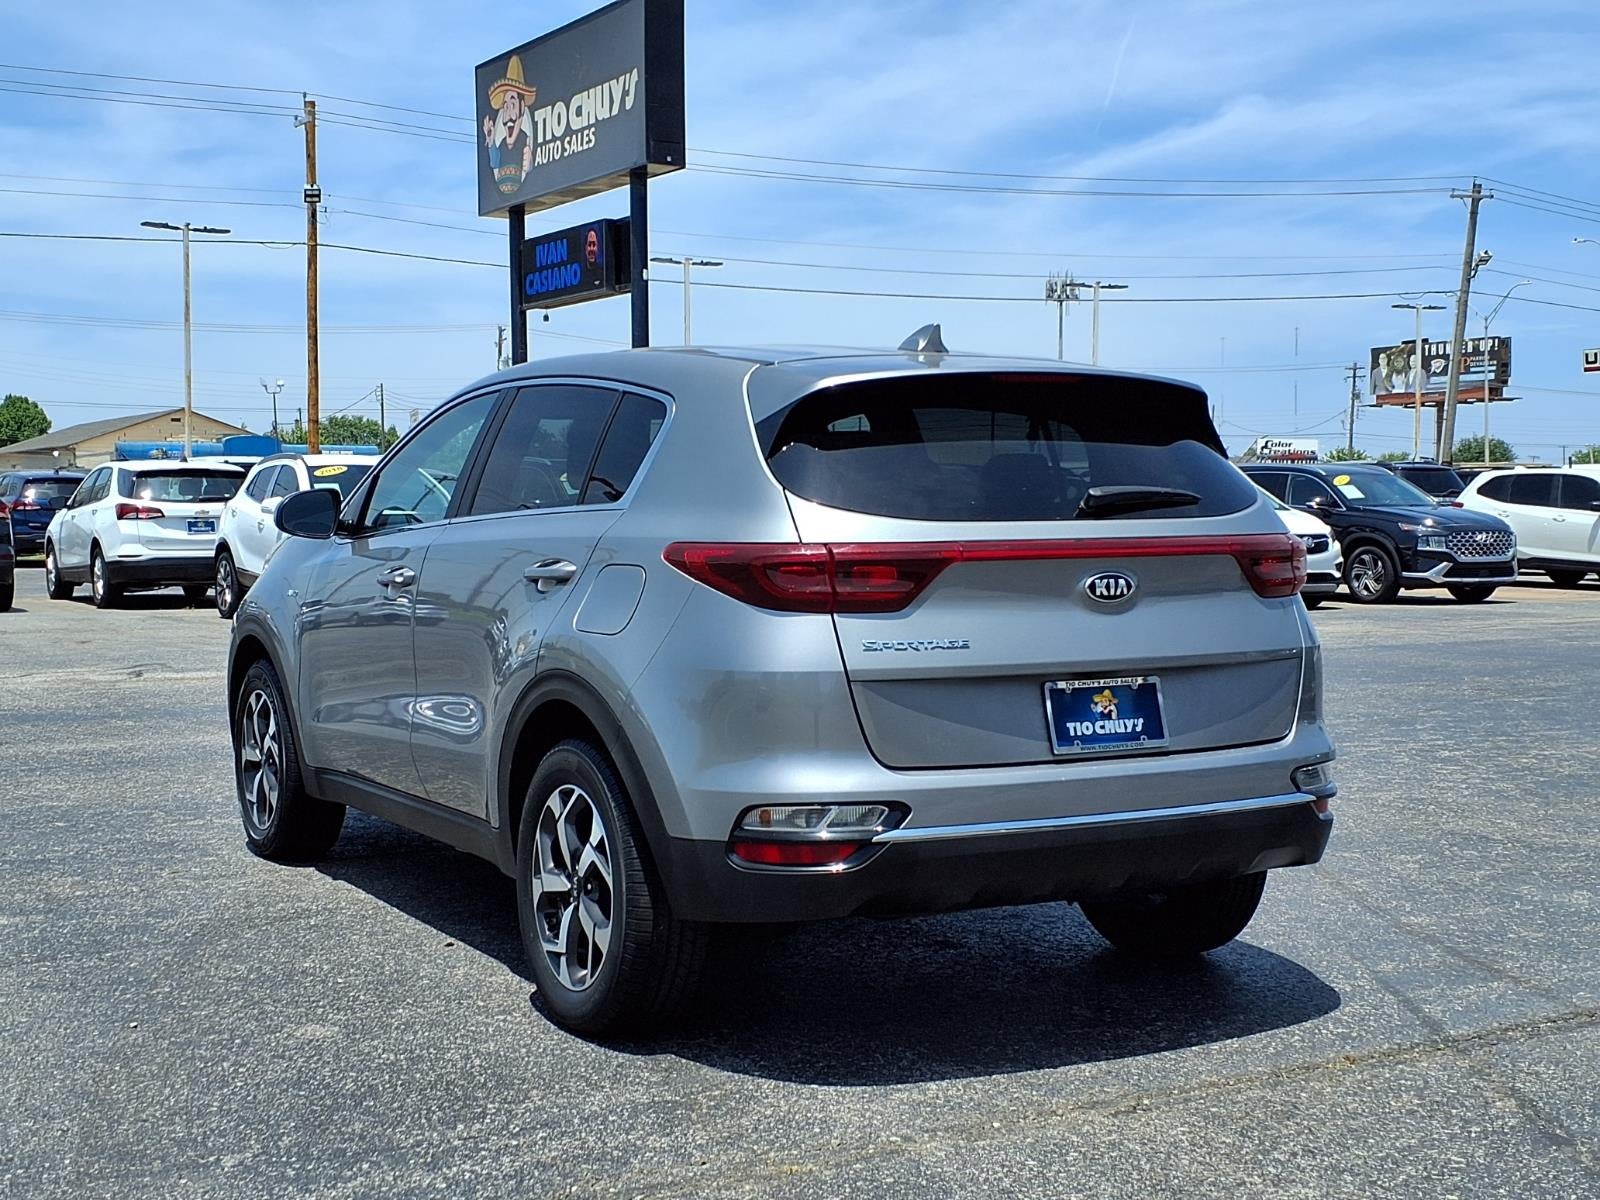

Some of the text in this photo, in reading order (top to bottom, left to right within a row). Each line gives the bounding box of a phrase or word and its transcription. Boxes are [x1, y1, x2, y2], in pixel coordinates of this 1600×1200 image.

[534, 67, 639, 144] TIO CHUY'S
[534, 127, 596, 167] AUTO SALES
[535, 238, 568, 268] IVAN
[526, 262, 581, 296] CASIANO
[1424, 341, 1473, 357] THUNER
[1260, 447, 1316, 456] Creations
[1264, 440, 1293, 449] Color
[1094, 578, 1129, 596] KIA
[861, 639, 970, 652] SPORTAGE
[1066, 717, 1144, 736] TIO CHUY'S
